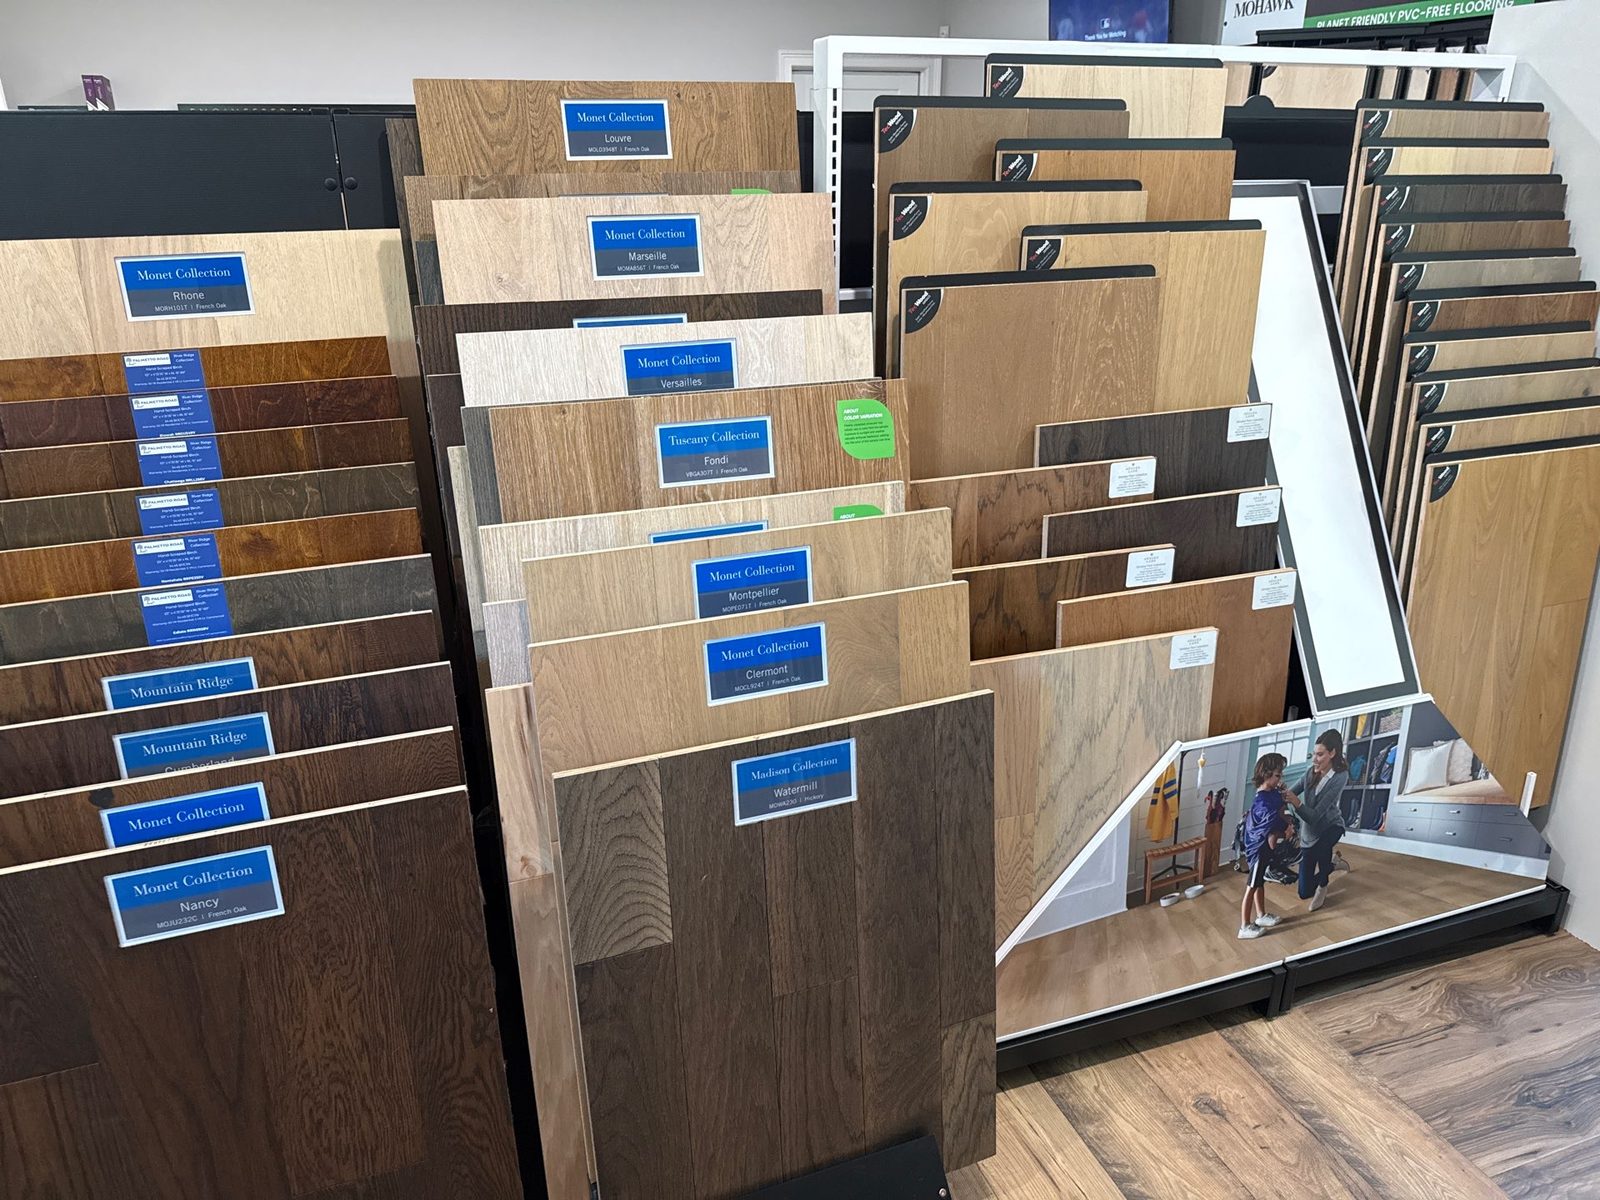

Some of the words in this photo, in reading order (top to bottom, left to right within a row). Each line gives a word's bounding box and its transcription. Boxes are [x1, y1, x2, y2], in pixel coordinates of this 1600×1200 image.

[1234, 0, 1294, 18] MOHAWK
[1350, 11, 1397, 27] FRIENDLY
[1397, 3, 1452, 22] PVC-FREE
[577, 112, 607, 123] Monet
[608, 111, 654, 122] Collection
[604, 134, 632, 143] Louvre
[605, 229, 635, 240] Monet
[638, 228, 686, 239] Collection
[628, 251, 667, 261] Marseille
[137, 270, 173, 281] Monet
[175, 267, 231, 279] Collection
[173, 291, 205, 301] Rhone
[638, 358, 669, 369] Monet
[671, 354, 721, 367] Collection
[660, 377, 703, 389] Versailles
[668, 435, 709, 446] Tuscany
[712, 430, 760, 442] Collection
[704, 454, 729, 465] Fondi
[720, 467, 738, 475] French
[710, 571, 742, 583] Monet
[744, 564, 795, 578] Collection
[729, 587, 780, 602] Montpellier
[721, 650, 755, 662] Monet
[757, 640, 809, 655] Collection
[746, 664, 788, 680] Clermont
[130, 681, 194, 700] Mountain
[197, 676, 233, 690] Ridge
[143, 738, 207, 757] Mountain
[210, 732, 247, 745] Ridge
[751, 767, 790, 781] Madison
[792, 757, 838, 773] Collection
[773, 781, 818, 798] Watermill
[128, 815, 173, 832] Monet
[176, 802, 245, 823] Collection
[133, 880, 179, 897] Monet
[182, 867, 253, 888] Collection
[180, 897, 220, 913] Nancy
[208, 909, 232, 919] French
[233, 905, 248, 913] Oak
